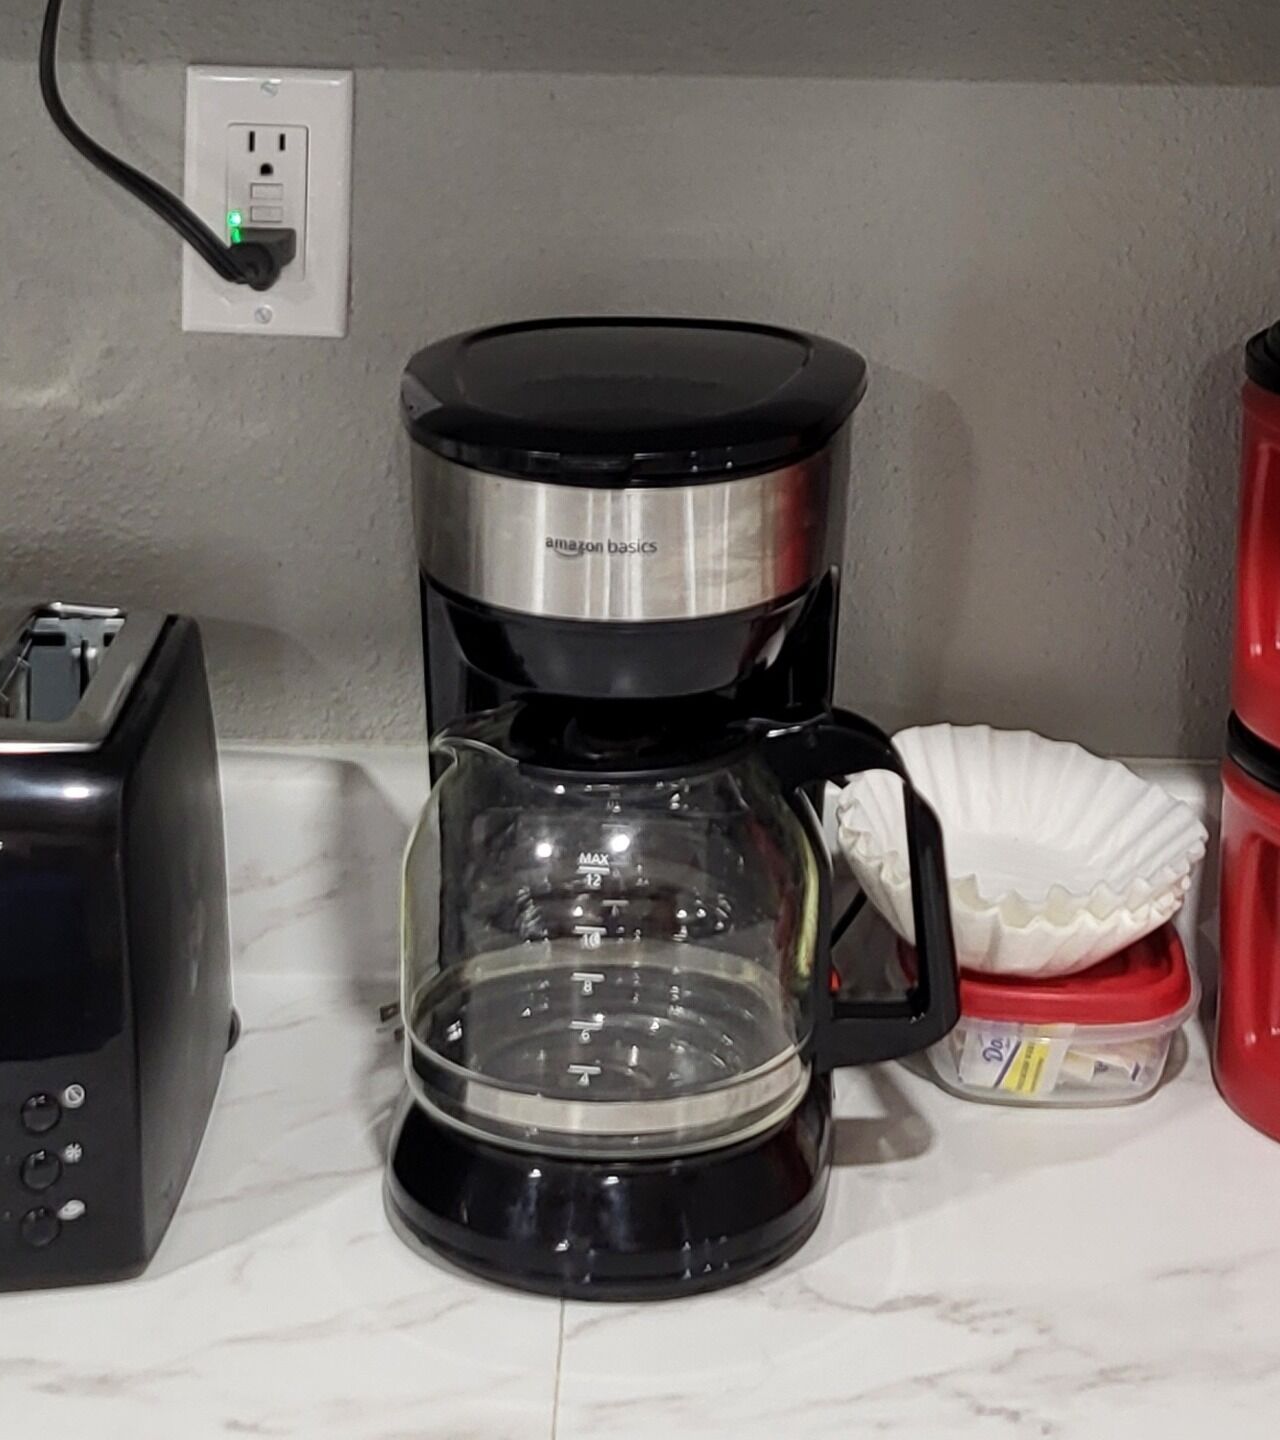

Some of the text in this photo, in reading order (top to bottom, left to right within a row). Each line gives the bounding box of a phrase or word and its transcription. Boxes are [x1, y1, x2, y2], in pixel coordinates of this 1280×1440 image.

[545, 537, 658, 556] amazon basics
[578, 852, 609, 865] MAX
[586, 873, 602, 887] 12
